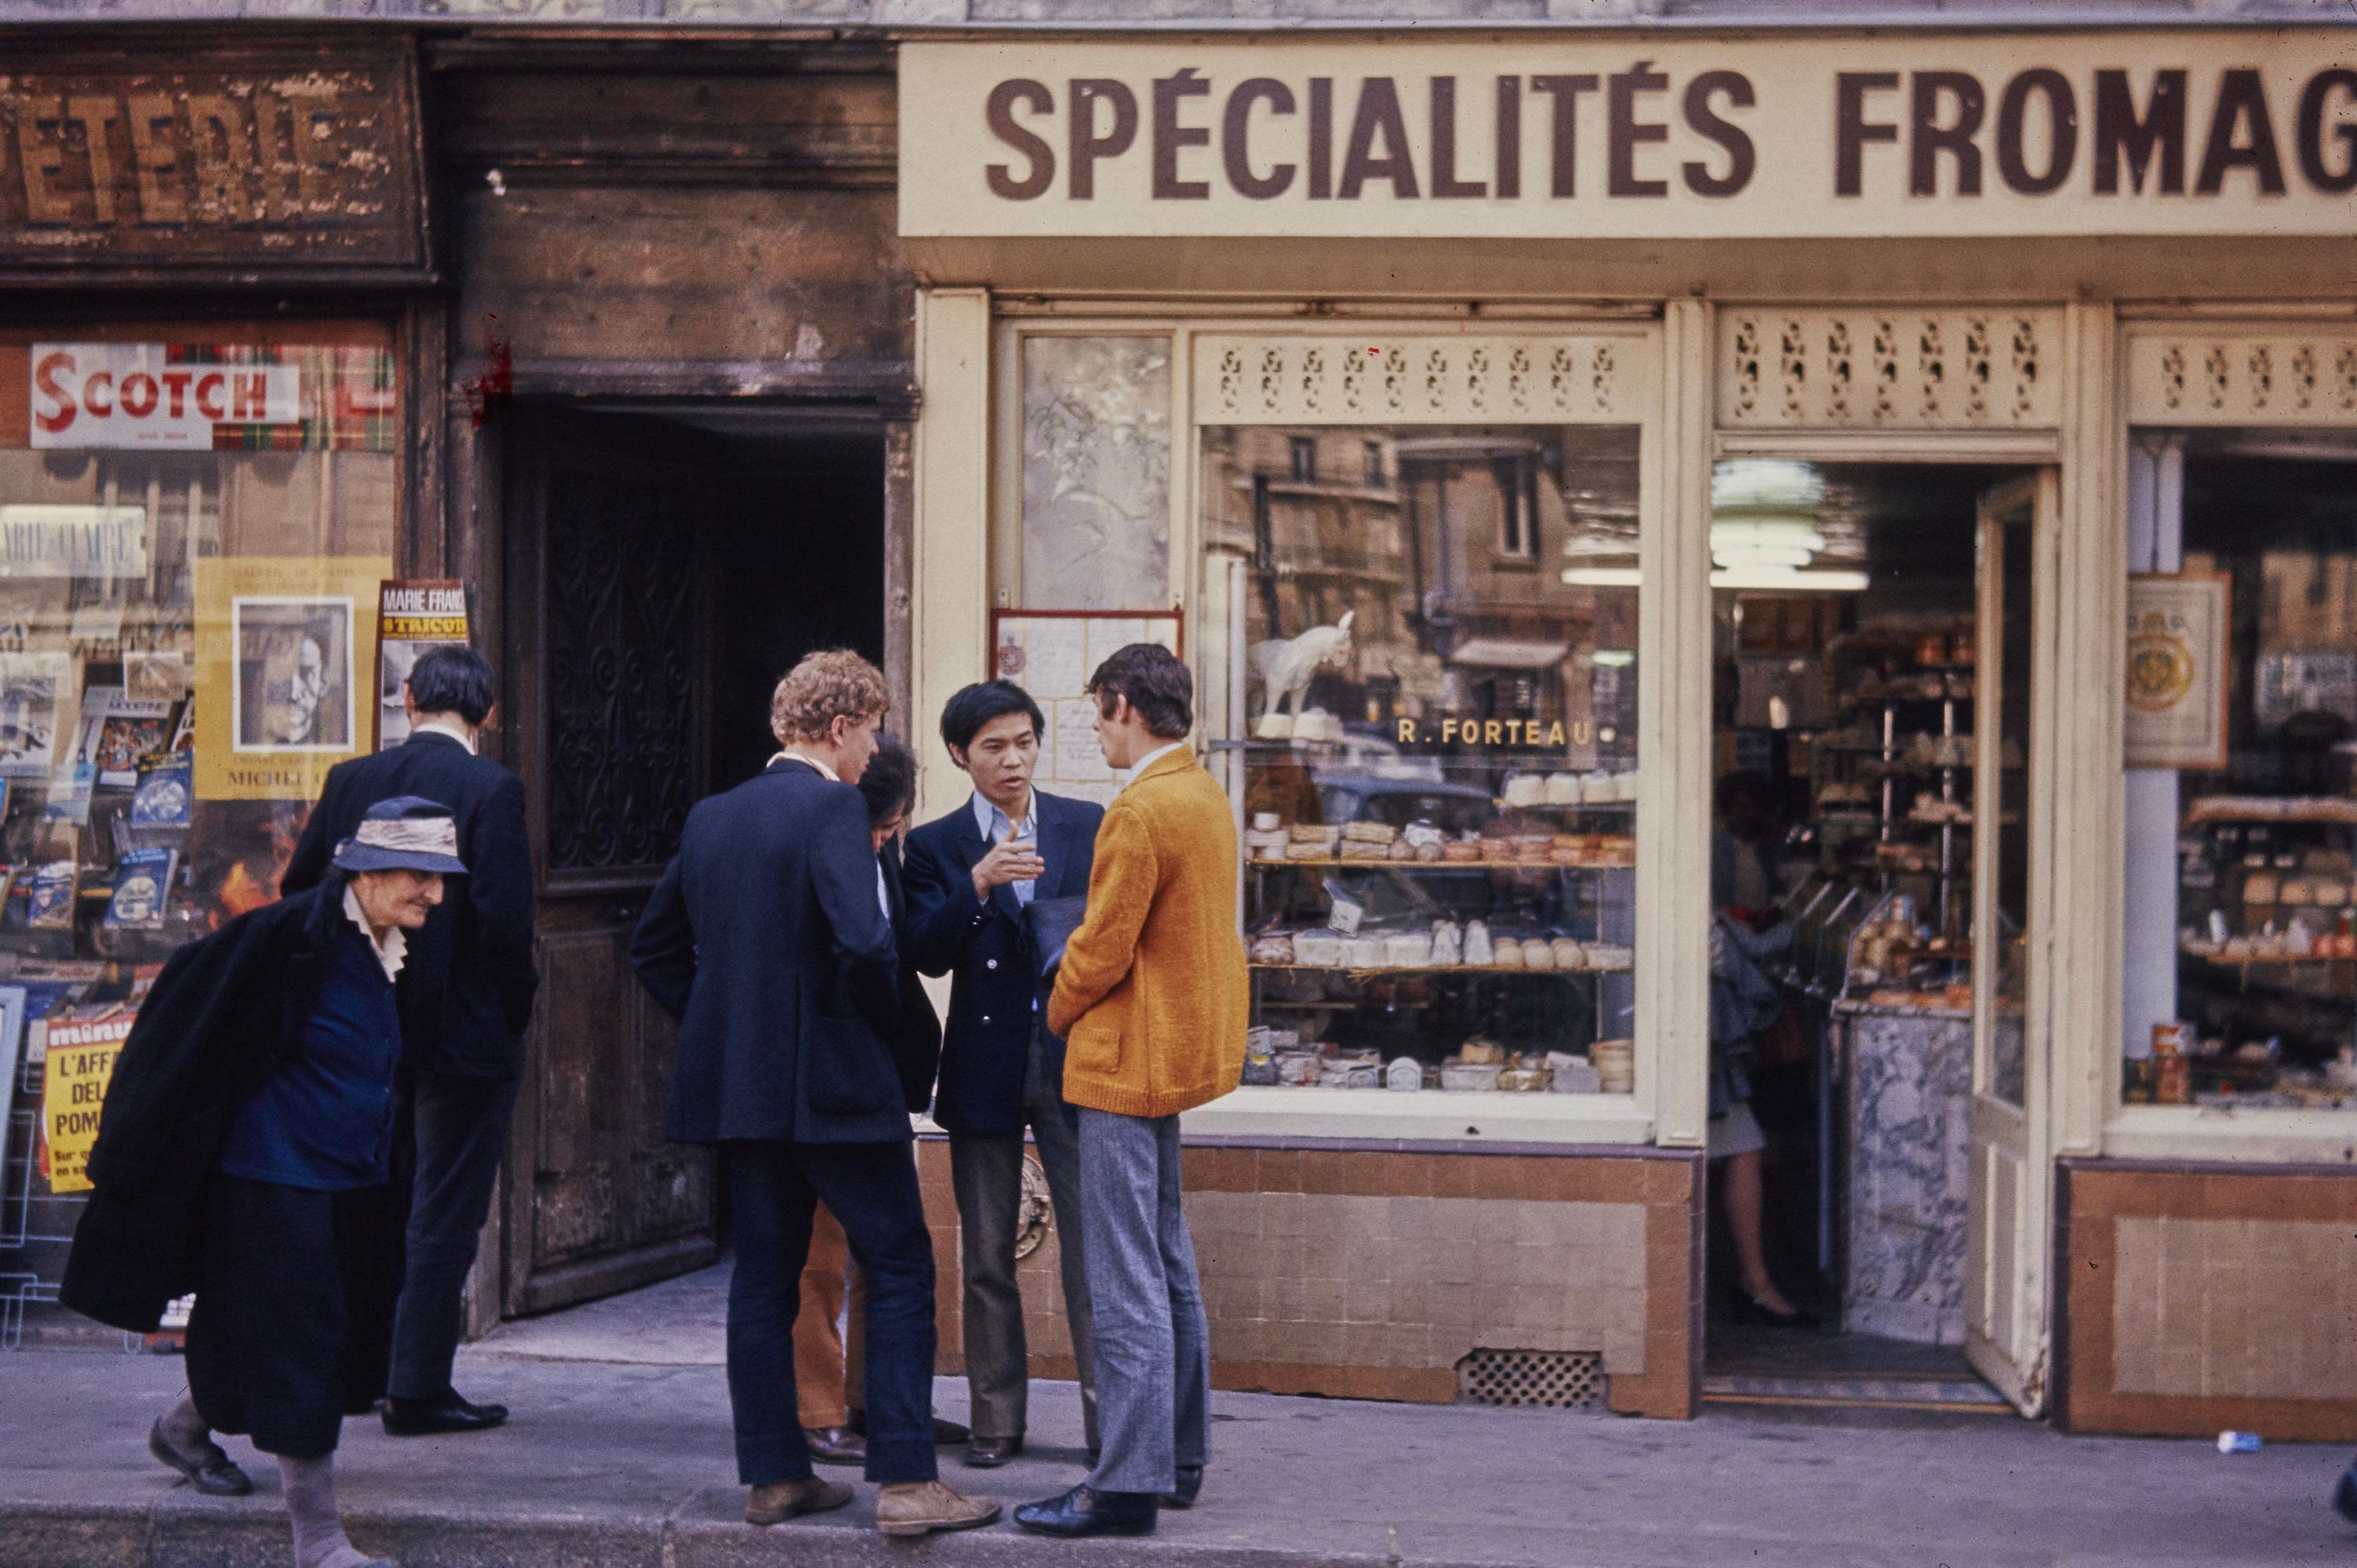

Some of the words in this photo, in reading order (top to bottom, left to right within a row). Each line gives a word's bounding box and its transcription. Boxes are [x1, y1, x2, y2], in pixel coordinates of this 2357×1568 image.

[0, 94, 349, 224] ETERIE
[985, 62, 1756, 201] SPÉCIALITÉS
[1835, 68, 2357, 196] FROMAG
[383, 588, 426, 611] MARIE
[1442, 718, 1591, 745] FORTEAU
